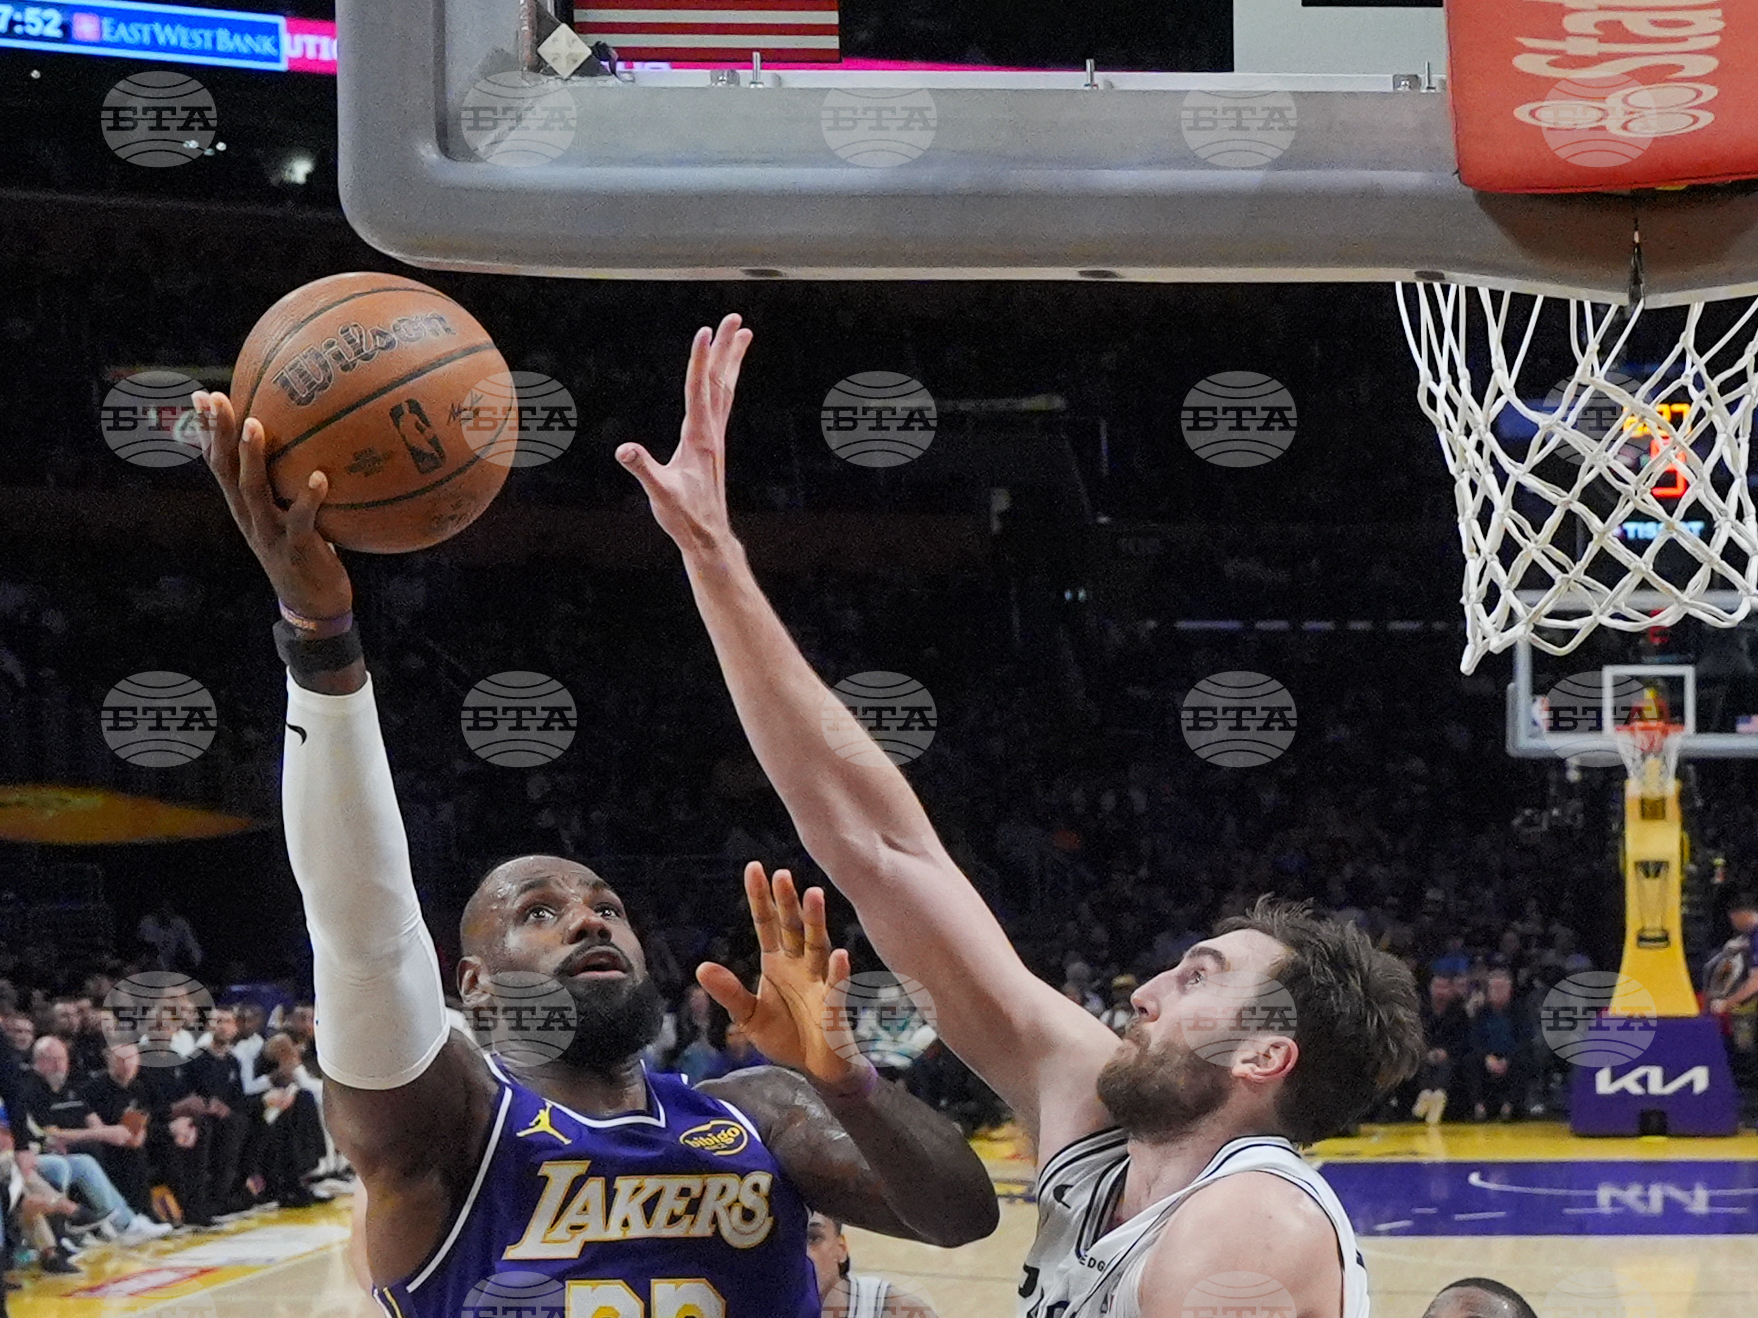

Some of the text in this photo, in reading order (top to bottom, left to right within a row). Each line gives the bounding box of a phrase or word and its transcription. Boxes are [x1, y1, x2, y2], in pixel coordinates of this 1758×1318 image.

[1512, 0, 1726, 78] Sta
[271, 311, 456, 407] Wilson
[685, 1126, 741, 1148] bibigo
[502, 1160, 775, 1260] LAKERS
